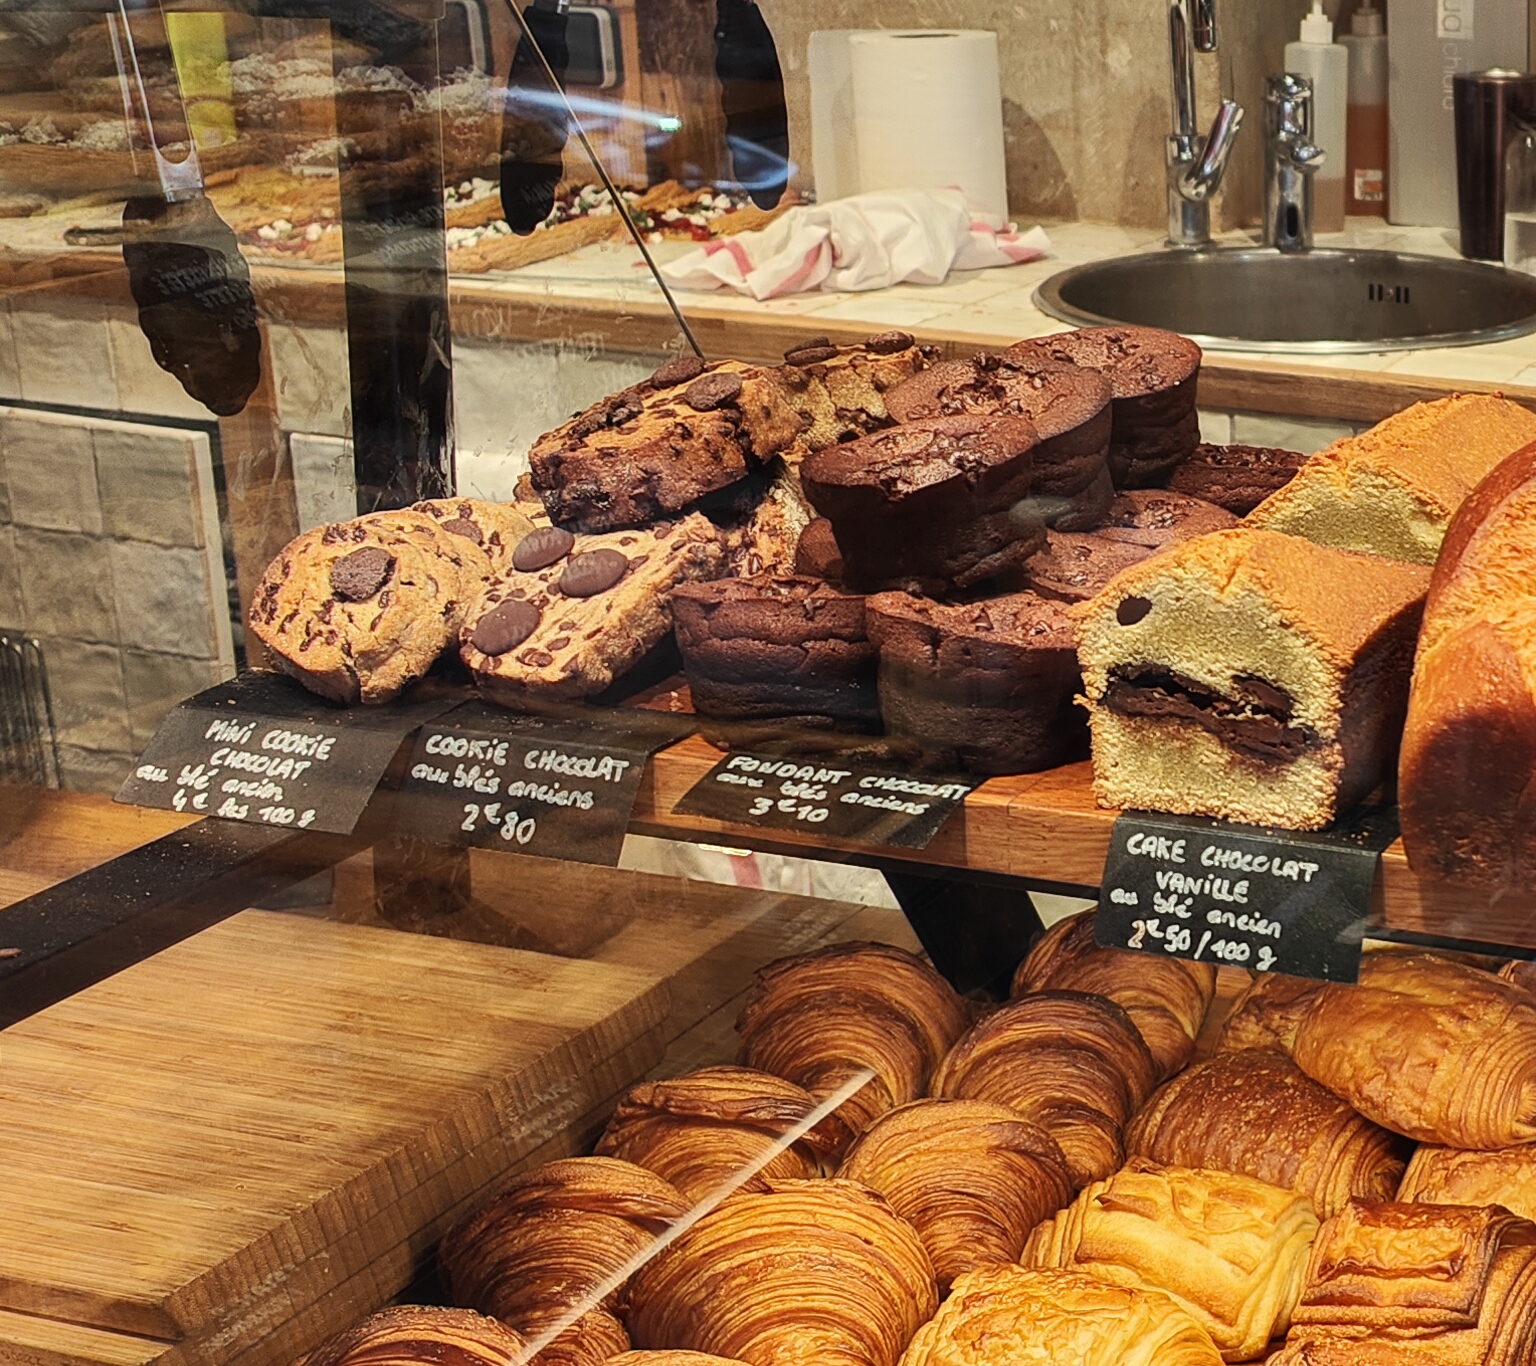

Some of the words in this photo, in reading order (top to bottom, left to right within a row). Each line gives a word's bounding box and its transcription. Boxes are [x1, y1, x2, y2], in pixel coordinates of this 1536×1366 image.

[135, 764, 170, 782] au
[209, 747, 312, 780] CHOCOLAT
[523, 749, 630, 783] CHOCOLAT
[726, 755, 852, 785] FONDANT
[858, 776, 972, 801] CHOCOLAT
[411, 763, 450, 784] aux
[452, 763, 502, 794] blés
[508, 781, 595, 810] anciens
[715, 772, 764, 789] aux
[779, 779, 829, 802] blés
[840, 792, 931, 816] anciens
[1126, 832, 1187, 864] CAKE
[1200, 845, 1320, 883] CHOCOLAT
[1109, 887, 1139, 906] au
[1152, 892, 1195, 919] blé
[1206, 909, 1283, 939] ancien
